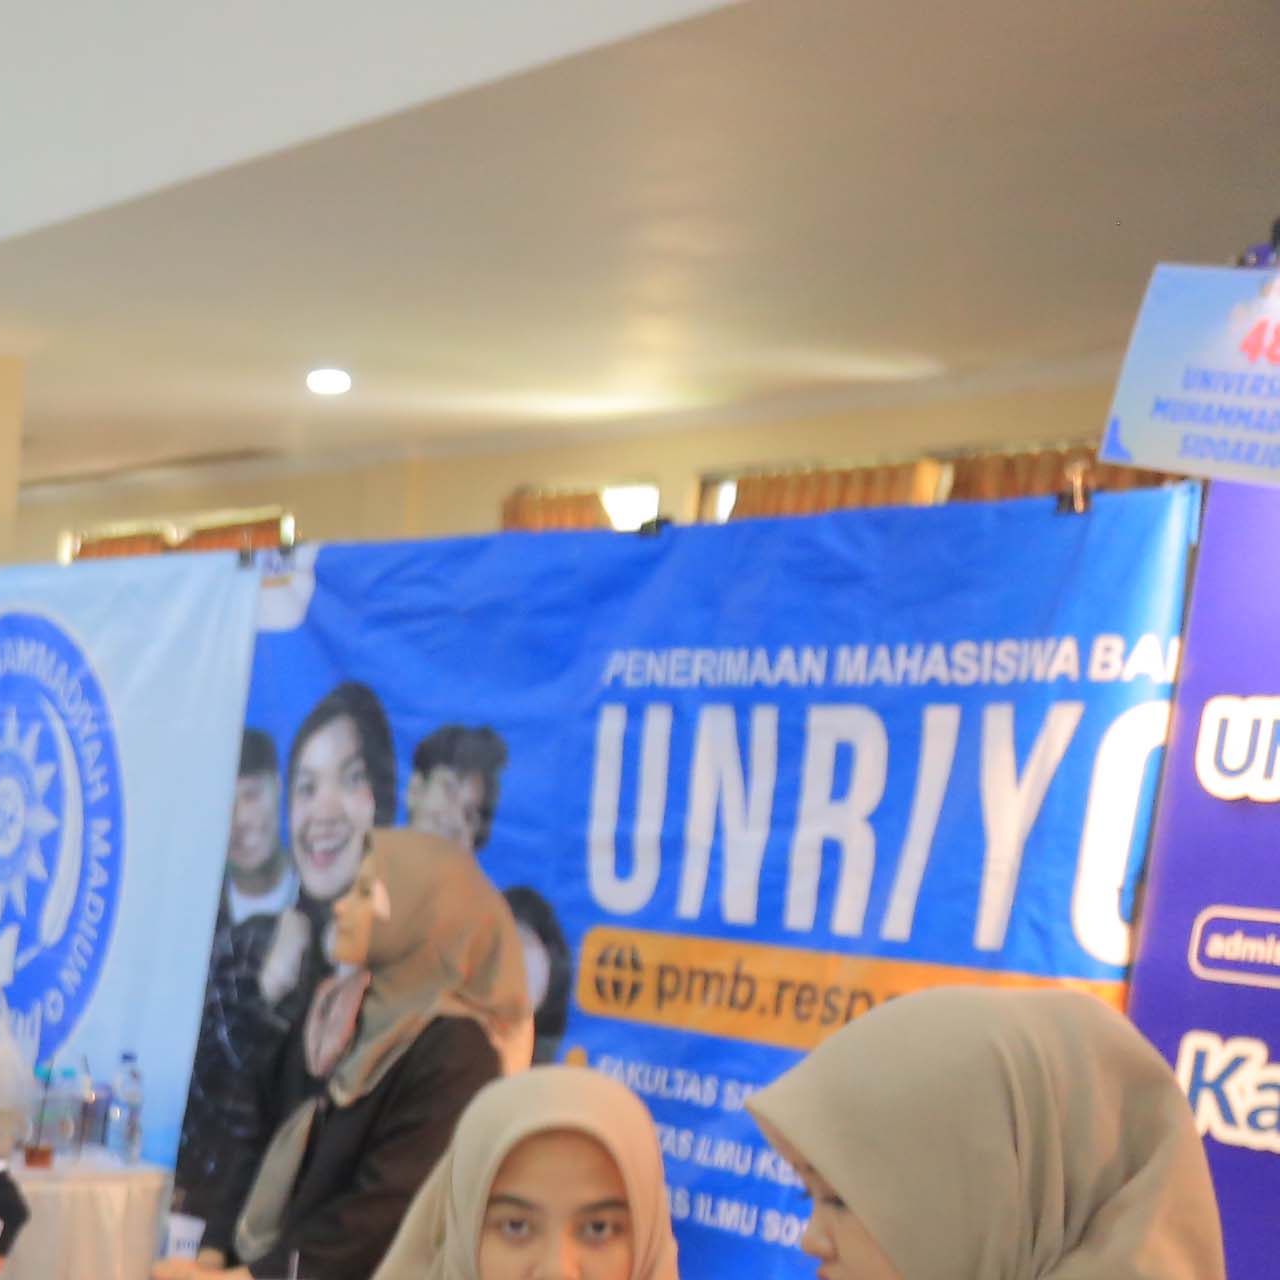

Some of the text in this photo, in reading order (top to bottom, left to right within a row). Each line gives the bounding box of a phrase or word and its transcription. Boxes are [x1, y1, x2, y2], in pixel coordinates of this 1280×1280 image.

[603, 646, 830, 689] PENERIMAAN
[833, 633, 1080, 686] MAHASISWA
[656, 957, 902, 1027] pmb.resp
